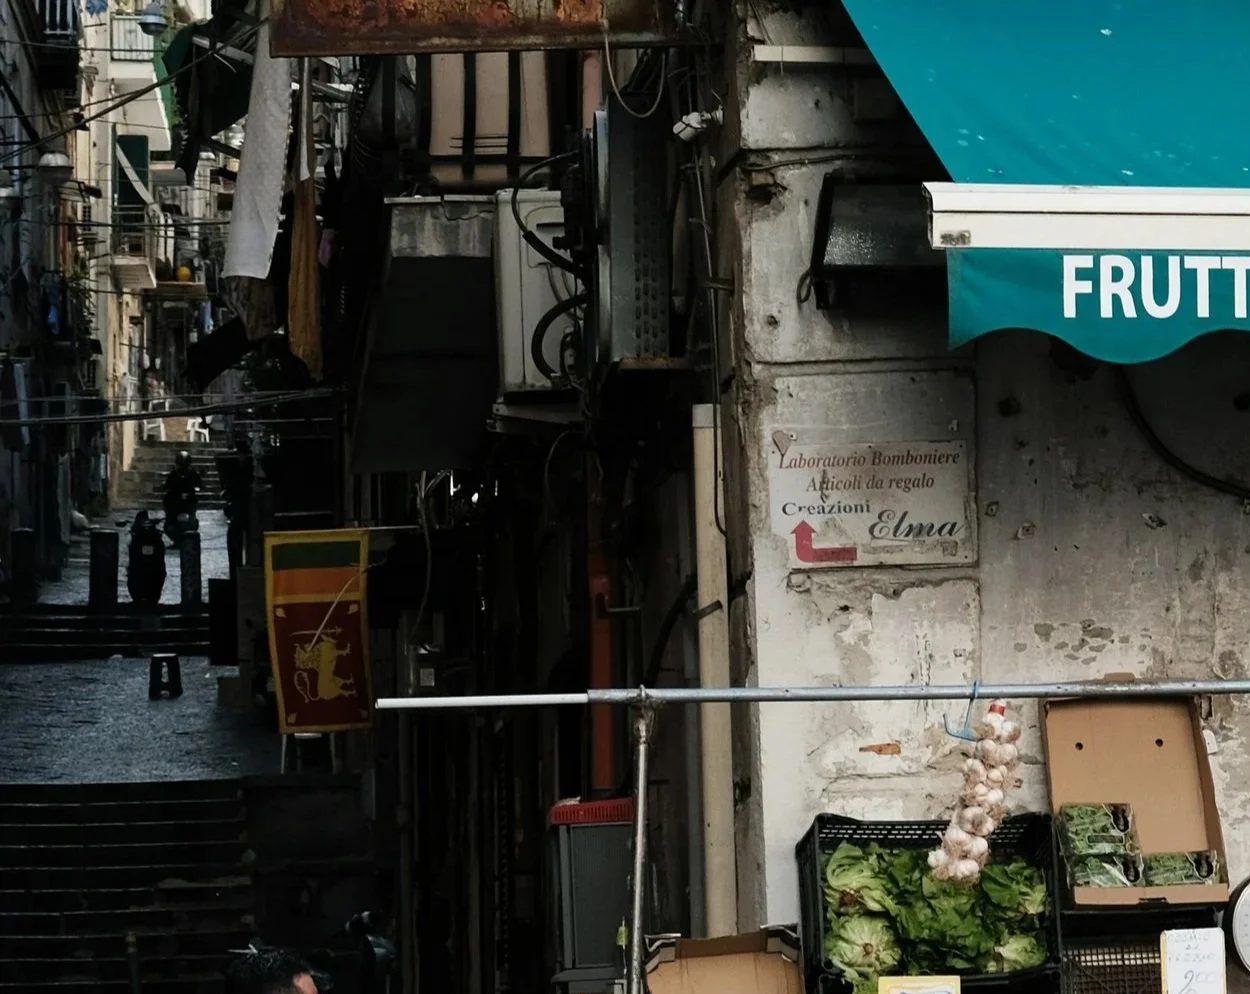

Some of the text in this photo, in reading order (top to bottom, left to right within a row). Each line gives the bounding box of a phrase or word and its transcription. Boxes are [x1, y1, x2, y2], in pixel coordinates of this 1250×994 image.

[779, 450, 960, 469] Laboratorio Bomboniere
[806, 472, 935, 494] Articoli da regalo
[782, 500, 871, 516] Creazioni
[868, 508, 966, 540] Elma
